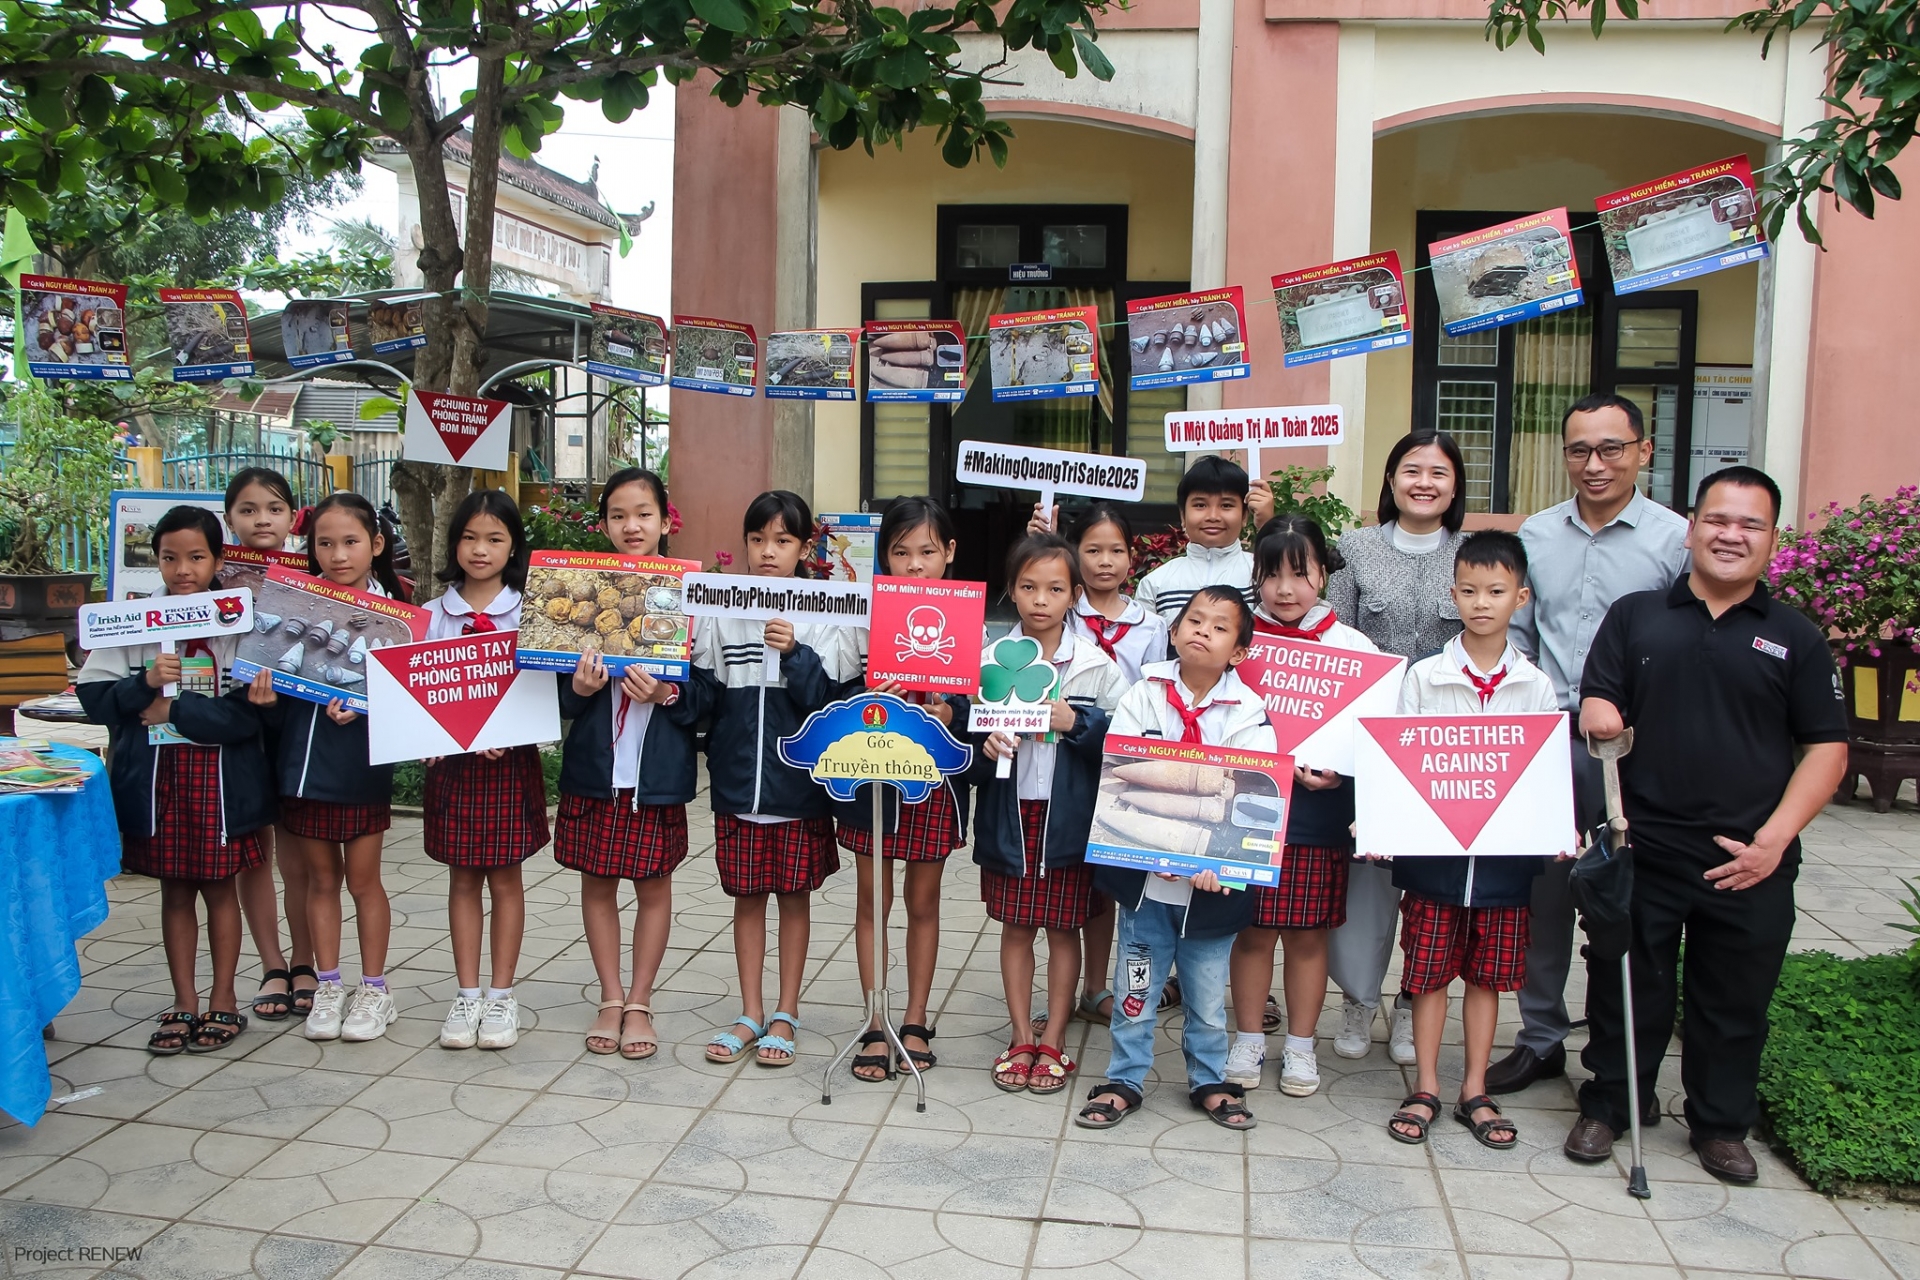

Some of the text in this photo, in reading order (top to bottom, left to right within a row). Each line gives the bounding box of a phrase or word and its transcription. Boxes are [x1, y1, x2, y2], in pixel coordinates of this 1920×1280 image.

[1630, 188, 1653, 199] NGUY
[1655, 180, 1677, 192] HIỂM,
[1690, 167, 1719, 180] TRÁNH
[1461, 236, 1480, 246] NGUY
[1482, 229, 1502, 240] HIỂM,
[1515, 219, 1540, 230] TRÁNH
[1013, 268, 1048, 280] HIỆU TRƯỞNG
[1302, 271, 1321, 280] NGUY
[1323, 266, 1341, 275] HIỂM,
[1352, 260, 1374, 269] TRÁNH
[1173, 297, 1190, 306] HIỂM,
[1200, 294, 1220, 302] TRÁNH
[433, 398, 488, 413] #CHUNG TAY
[432, 409, 487, 425] PHÒNG TRÁNH
[440, 422, 478, 435] BOM MÌN
[1170, 415, 1339, 446] Vì Một Quảng Trị An Toàn 2025
[964, 450, 1139, 490] #MakingQuangTriSafe2025
[241, 551, 265, 562] HIỂM,
[280, 557, 309, 566] TRÁNH
[596, 557, 621, 567] HIỂM,
[638, 562, 668, 570] TRÁNH
[297, 580, 306, 589] kỳ
[307, 582, 332, 595] NGUY
[333, 591, 355, 604] HIỂM,
[357, 599, 369, 608] hãy
[371, 601, 399, 615] TRÁNH
[687, 584, 867, 616] #ChungTayPhòngTránhBomMìn
[877, 583, 982, 598] BOM MÌN!! NGUY HIỂM!!
[98, 613, 141, 624] Irish Aid
[146, 610, 211, 627] RENEW
[409, 640, 511, 668] #CHUNG TAY
[1248, 644, 1363, 679] #TOGETHER
[409, 659, 514, 687] PHÒNG TRÁNH
[873, 671, 971, 686] DANGER!! MINES!!
[428, 682, 498, 705] BOM MÌN
[1259, 670, 1344, 699] AGAINST
[1263, 692, 1324, 720] MINES
[977, 717, 1042, 726] 0901 941 941
[867, 735, 893, 749] Góc
[1399, 725, 1525, 747] #TOGETHER
[1138, 746, 1147, 754] kỳ
[1149, 746, 1178, 757] NGUY
[1179, 747, 1207, 761] HIỂM,
[1208, 754, 1222, 763] hãy
[1225, 755, 1258, 766] TRÁNH
[1420, 752, 1510, 774] AGAINST
[821, 757, 933, 778] Truyền thông
[1430, 779, 1496, 800] MINES
